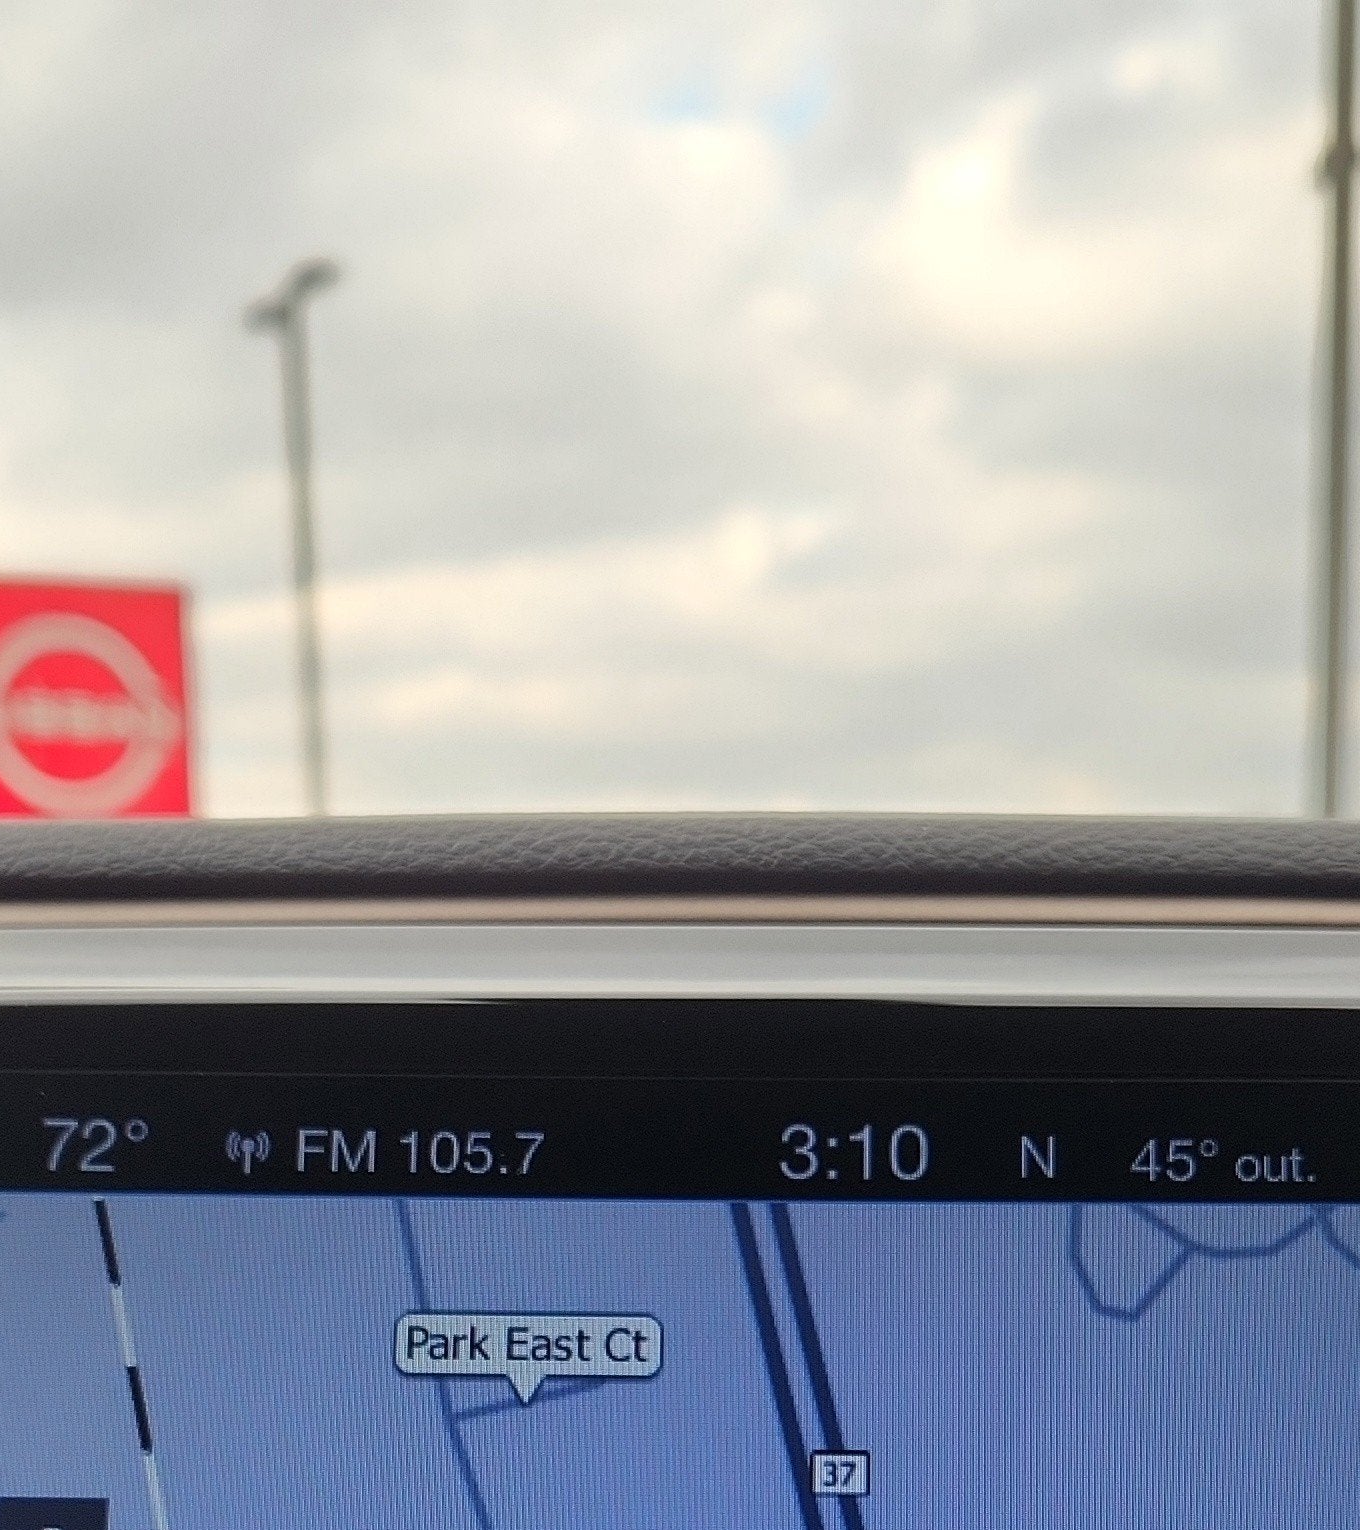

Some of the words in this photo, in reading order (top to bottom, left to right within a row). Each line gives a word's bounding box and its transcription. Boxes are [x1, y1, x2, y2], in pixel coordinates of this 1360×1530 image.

[43, 1117, 149, 1172] 72°
[297, 1128, 376, 1173] FM
[399, 1130, 545, 1175] 105.7
[780, 1123, 929, 1181] 3:10
[1020, 1135, 1054, 1179] N
[1130, 1138, 1218, 1182] 45°
[1234, 1148, 1315, 1183] out.
[406, 1325, 490, 1361] Park
[506, 1326, 591, 1362] East
[604, 1327, 648, 1363] Ct
[823, 1460, 857, 1488] 37
